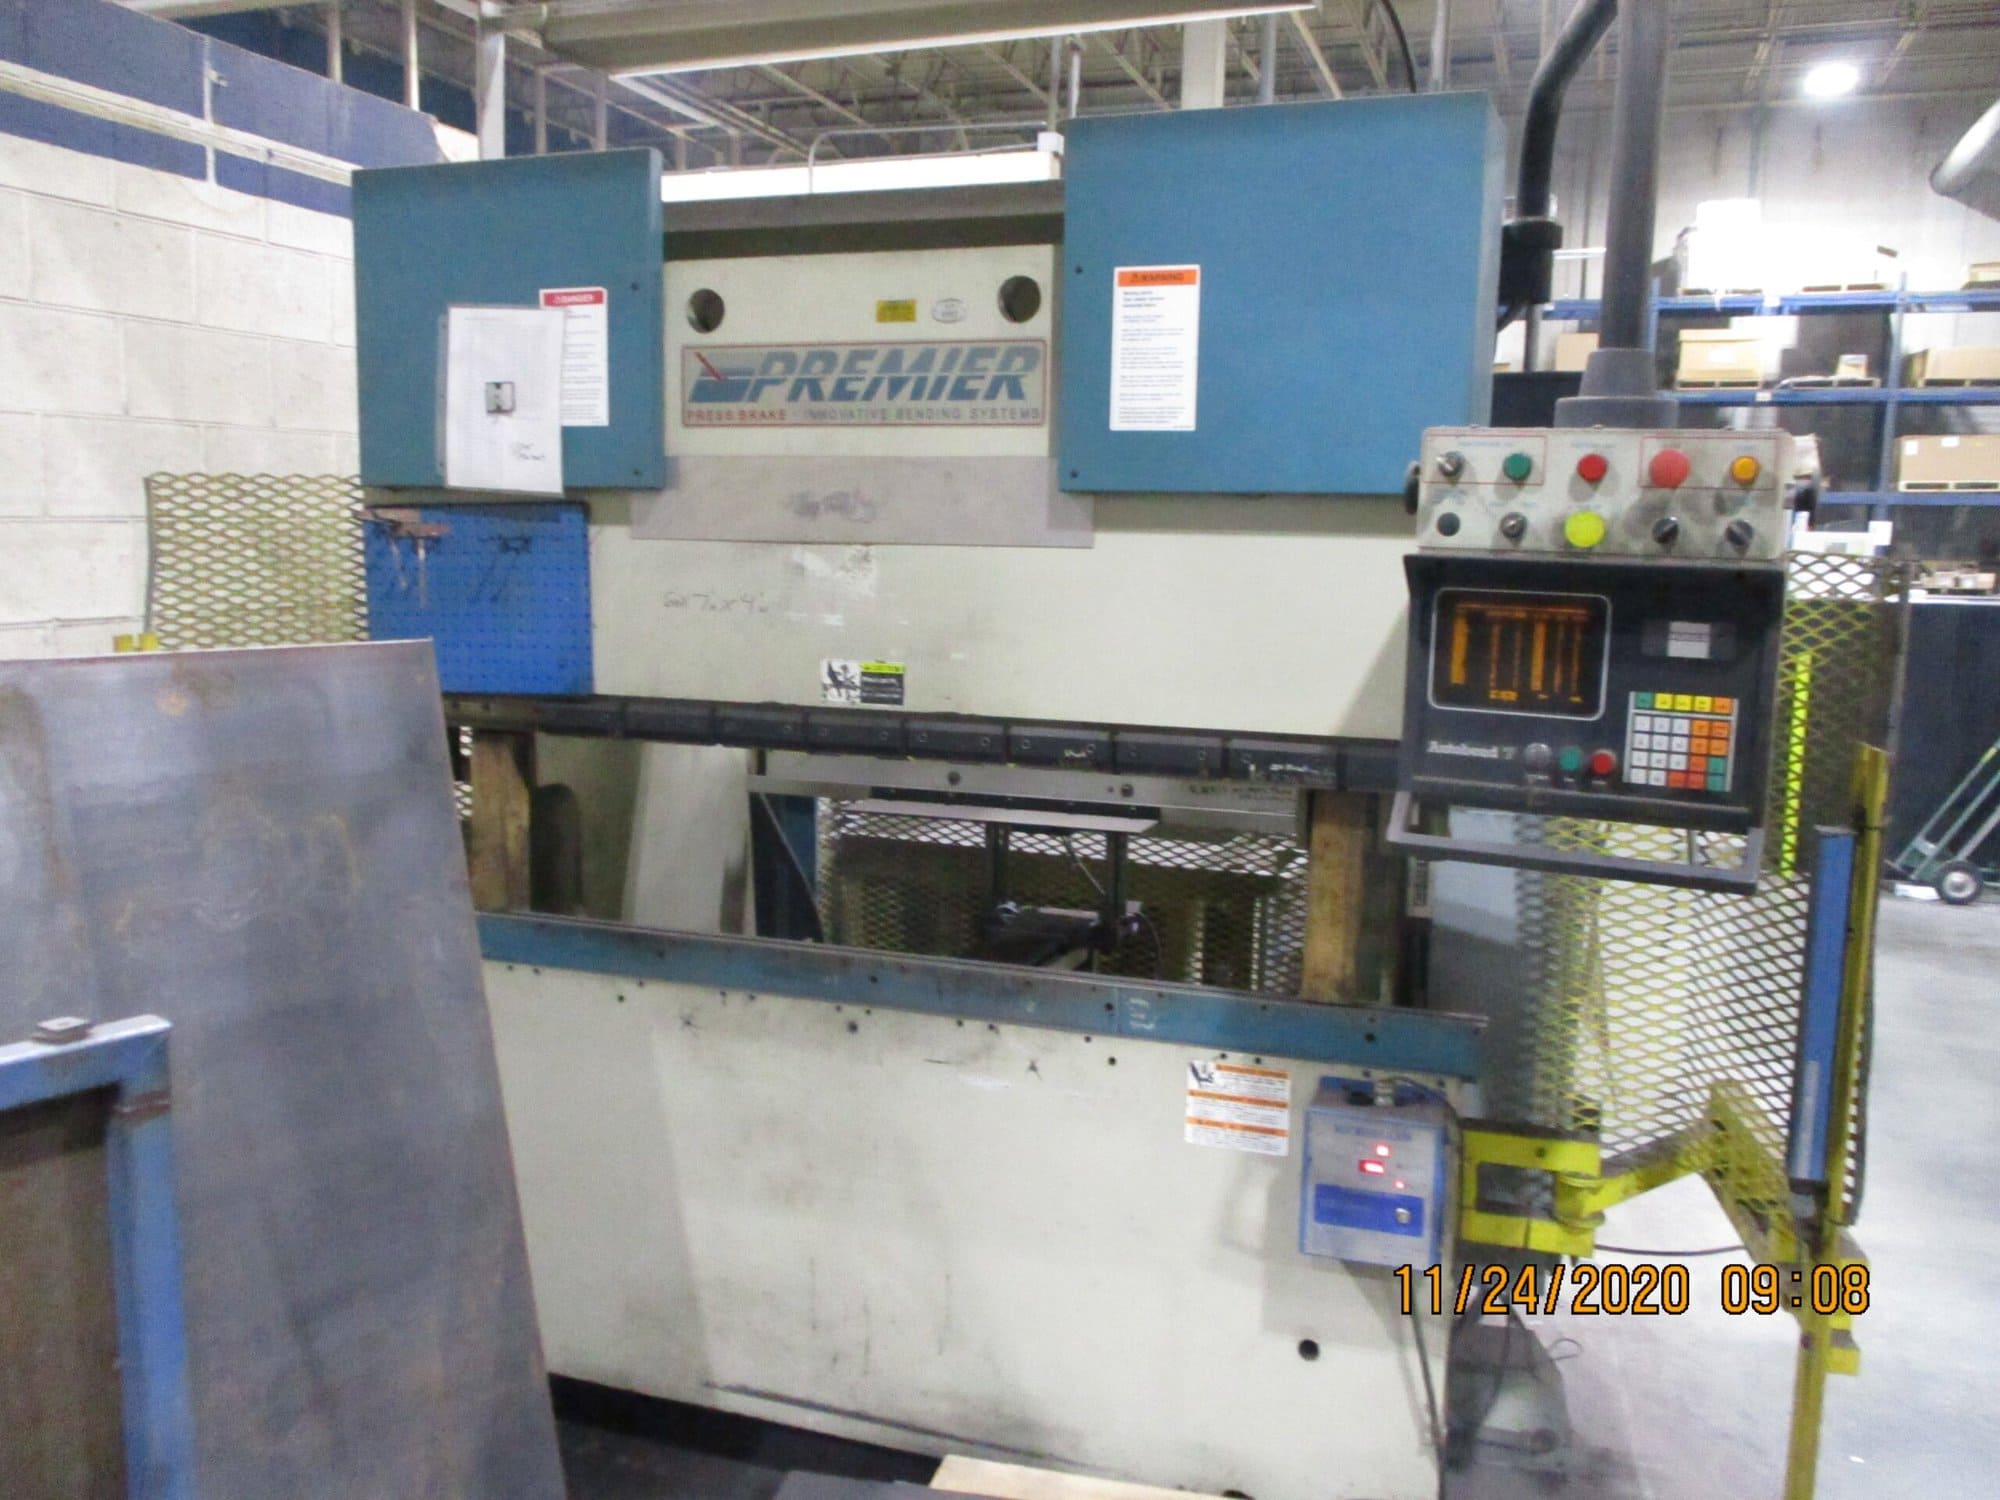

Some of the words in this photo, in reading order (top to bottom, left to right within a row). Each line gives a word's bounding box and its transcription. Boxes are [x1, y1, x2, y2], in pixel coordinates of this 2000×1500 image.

[747, 346, 1042, 403] PREMIER
[687, 409, 735, 421] PRESS
[738, 409, 787, 421] BRAKE
[804, 408, 887, 421] INNOVATIVE
[896, 407, 961, 420] BENDING
[969, 407, 1041, 420] SYSTEMS
